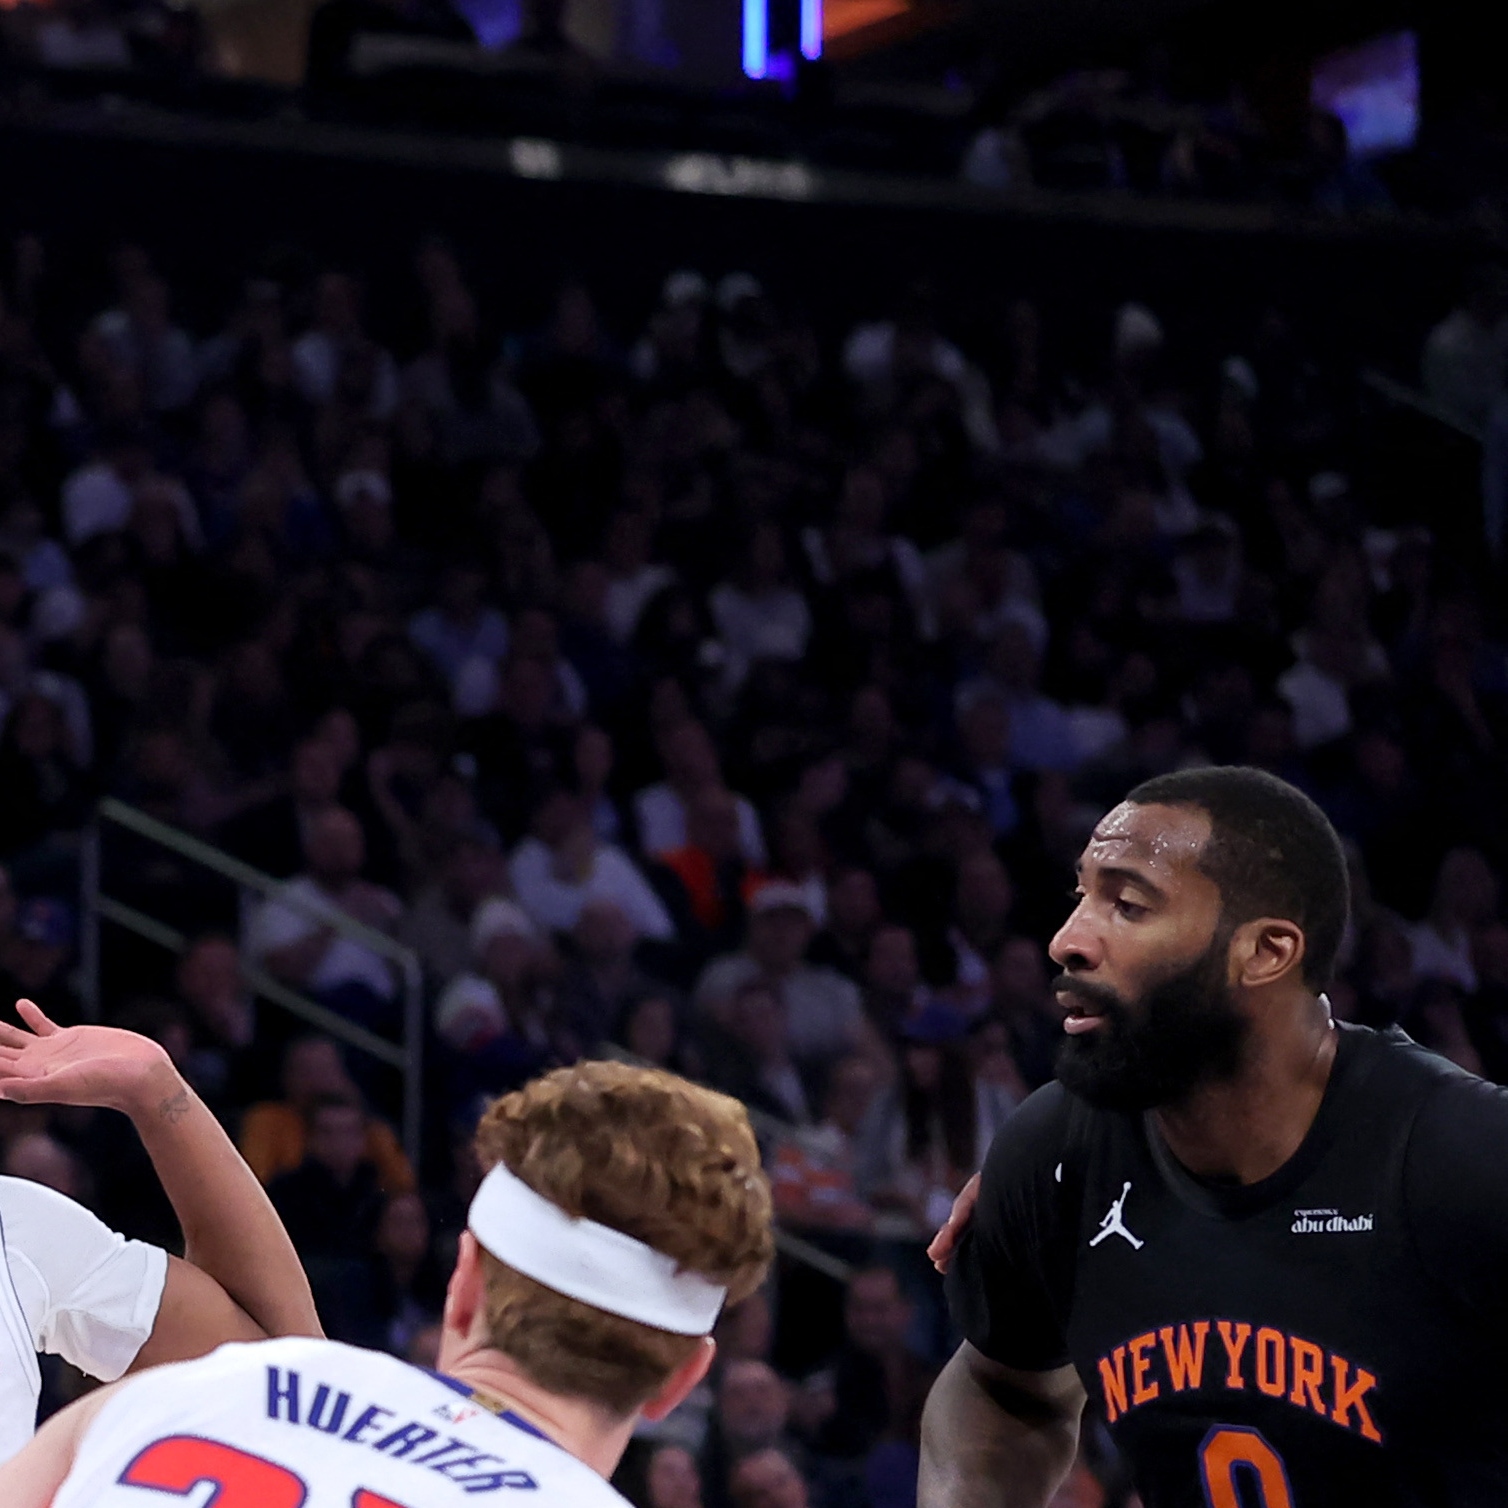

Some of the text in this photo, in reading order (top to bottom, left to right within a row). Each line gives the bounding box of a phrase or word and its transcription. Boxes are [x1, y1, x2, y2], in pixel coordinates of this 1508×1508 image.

[1290, 1213, 1374, 1234] abu dhabi
[266, 1365, 541, 1495] HUERTER
[1097, 1317, 1384, 1447] NEW YORK
